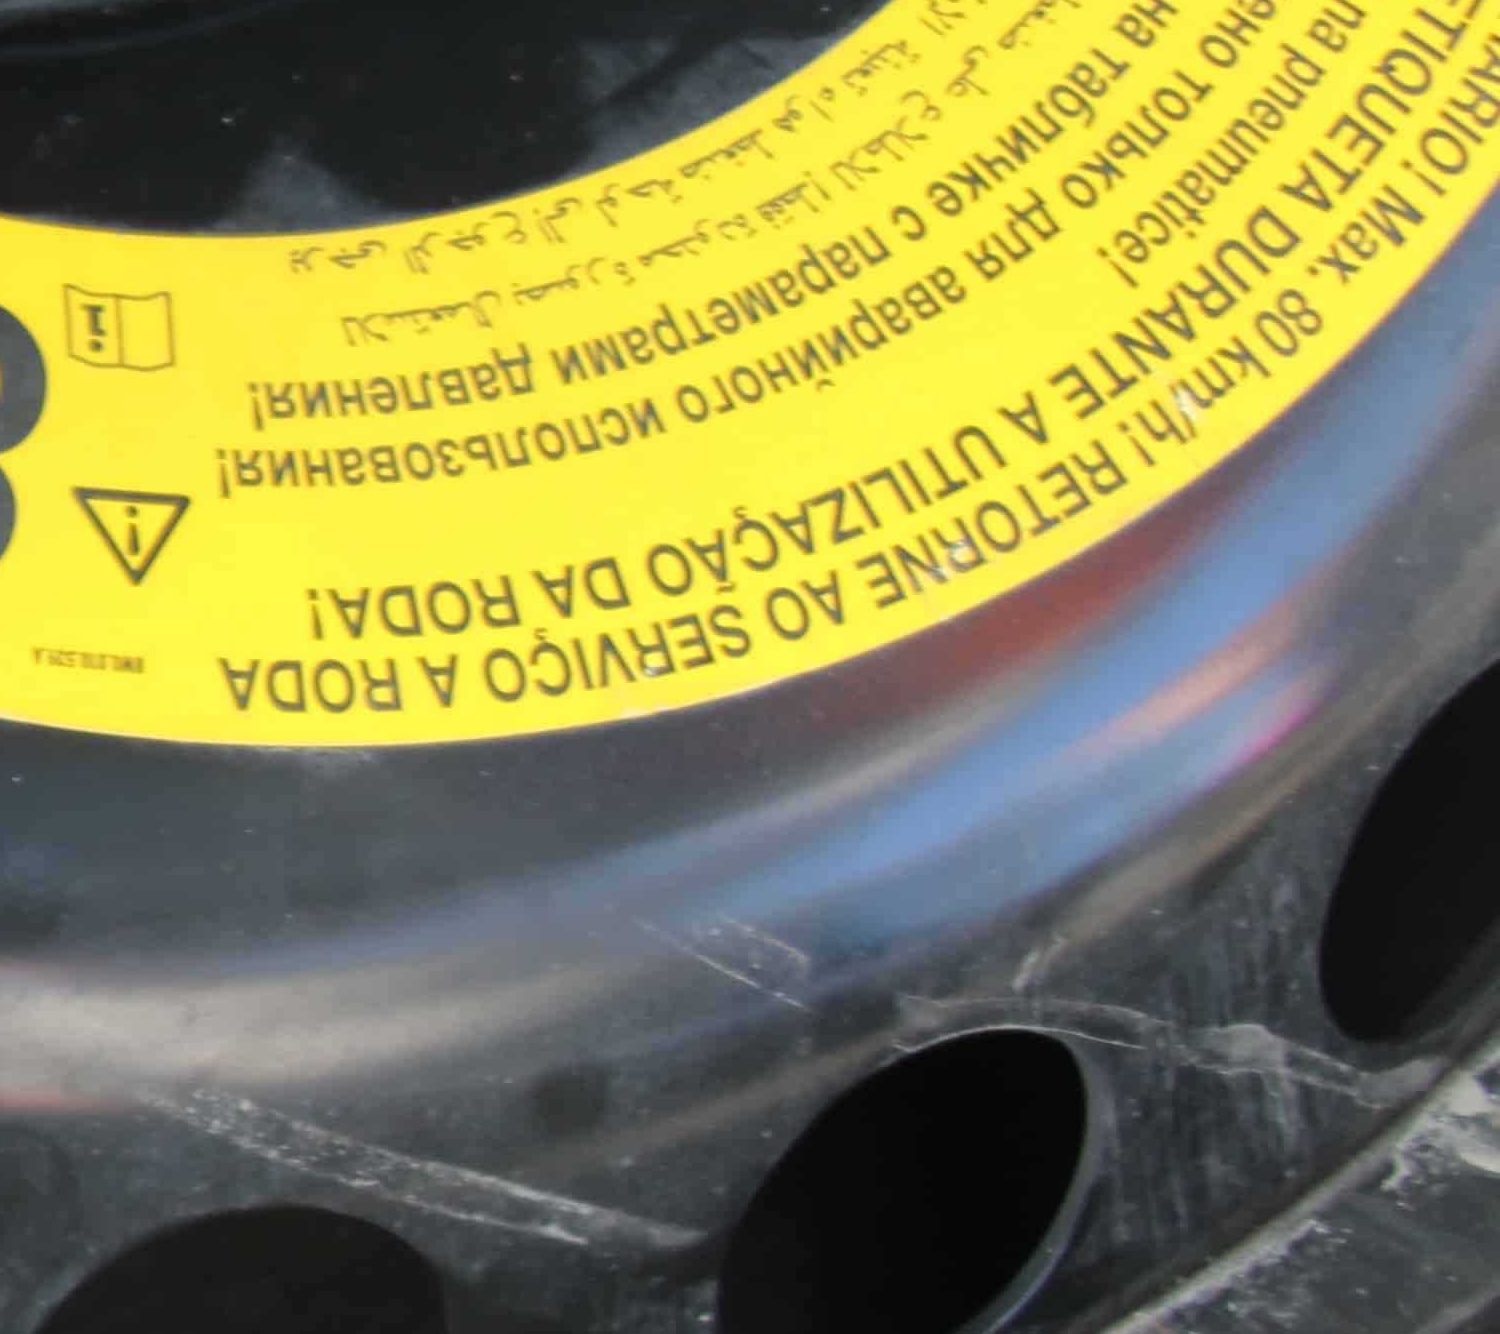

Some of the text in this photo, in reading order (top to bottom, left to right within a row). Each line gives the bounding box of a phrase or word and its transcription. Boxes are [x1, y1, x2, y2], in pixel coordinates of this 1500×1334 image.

[925, 47, 1131, 217] табличке
[1059, 69, 1214, 209] только
[1096, 41, 1327, 288] pneumatice!
[890, 204, 927, 242] с
[962, 187, 1062, 282] для
[549, 225, 893, 385] параметрами
[674, 264, 967, 424] аварийного
[1047, 204, 1303, 420] DURANTE
[215, 396, 666, 499] использования!
[218, 183, 1427, 714] Max. 80 km/h! RETORNE AO SERVIÇO A RODA
[247, 341, 535, 431] давления!
[996, 389, 1049, 445] A
[645, 424, 1008, 597] UTILIZAÇÃO
[306, 574, 522, 640] RODA!
[531, 555, 632, 619] DA
